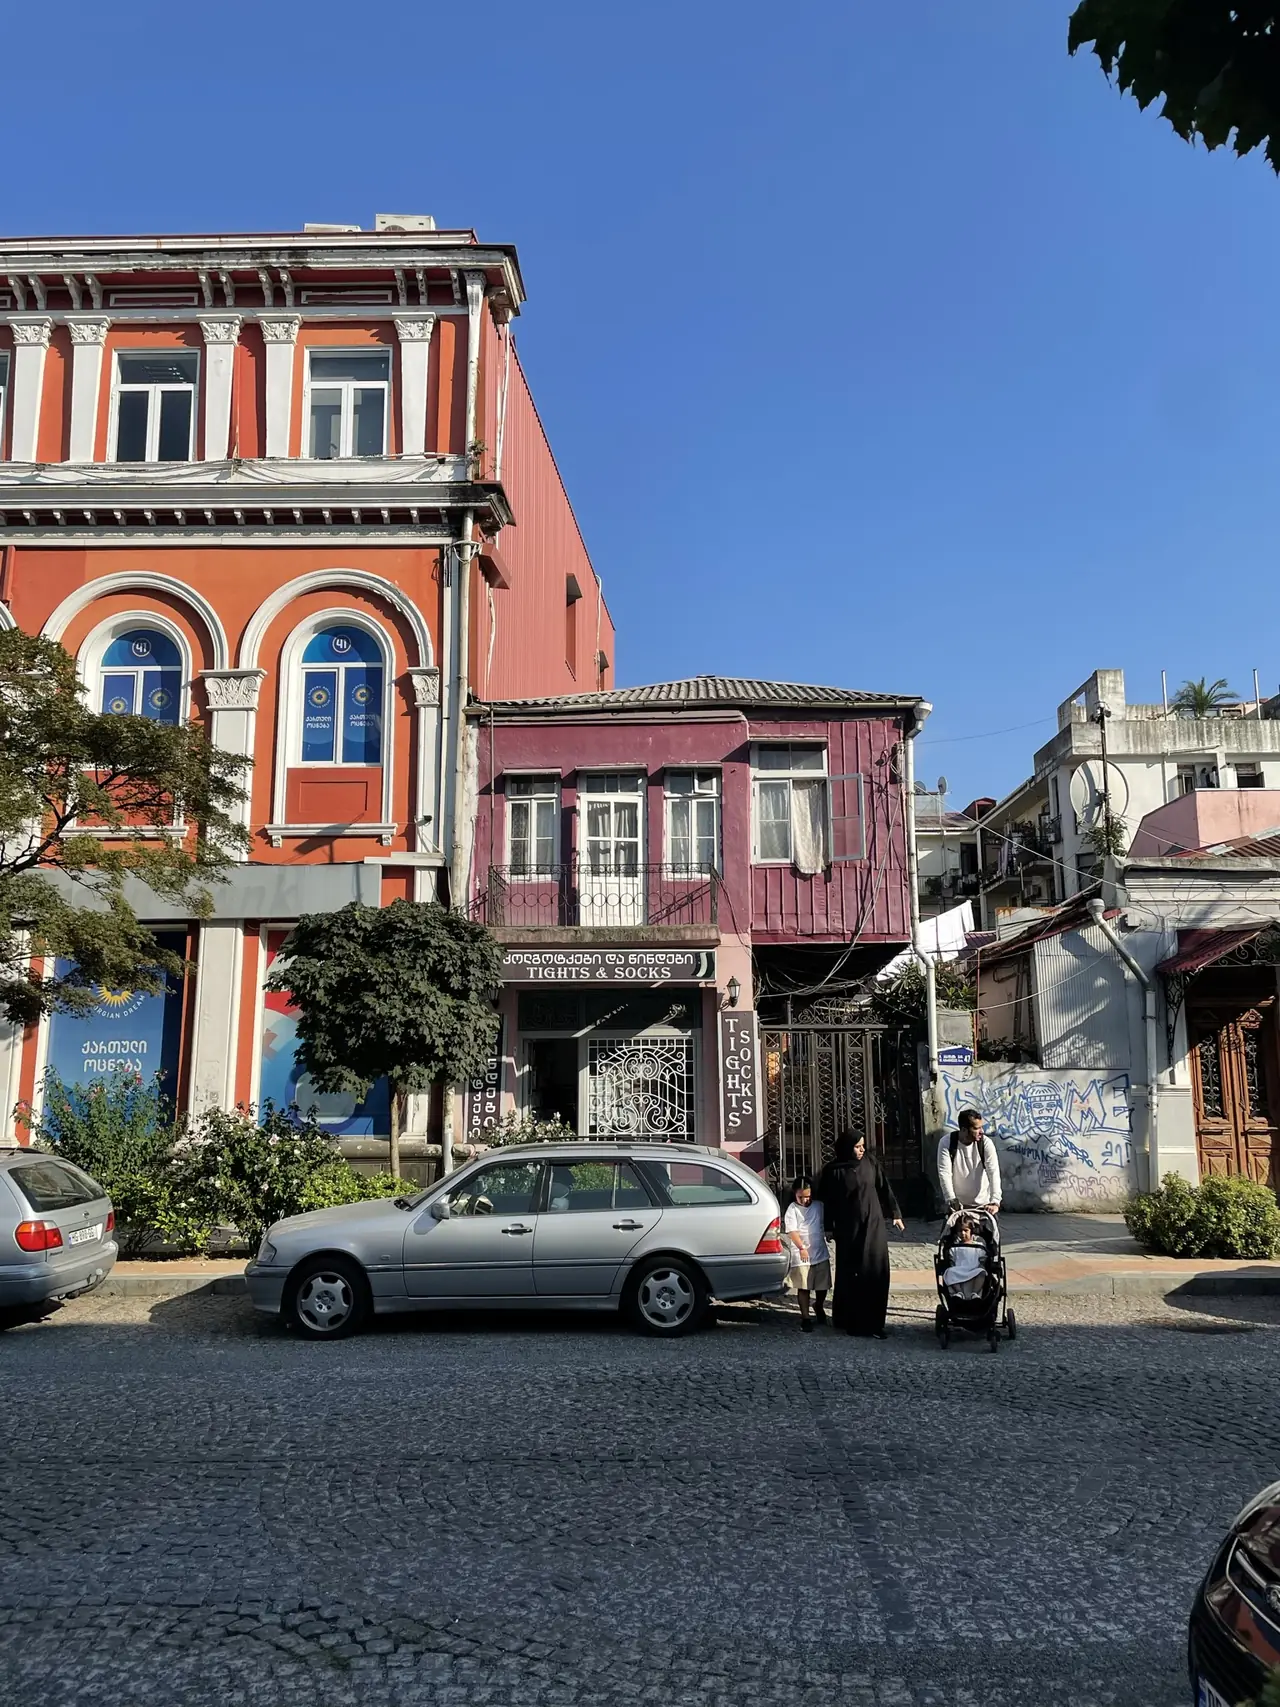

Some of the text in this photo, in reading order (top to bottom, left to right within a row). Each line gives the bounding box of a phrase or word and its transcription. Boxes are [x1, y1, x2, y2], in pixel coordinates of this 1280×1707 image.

[135, 642, 147, 653] 41
[335, 638, 348, 650] 41
[605, 954, 625, 965] და
[628, 953, 694, 965] წინდები
[526, 966, 672, 979] TIGHTS & SOCKS
[123, 994, 147, 1017] DREAM
[81, 1040, 148, 1055] ქართული
[724, 1018, 742, 1128] TIGHTS
[739, 1030, 754, 1115] SOCKS
